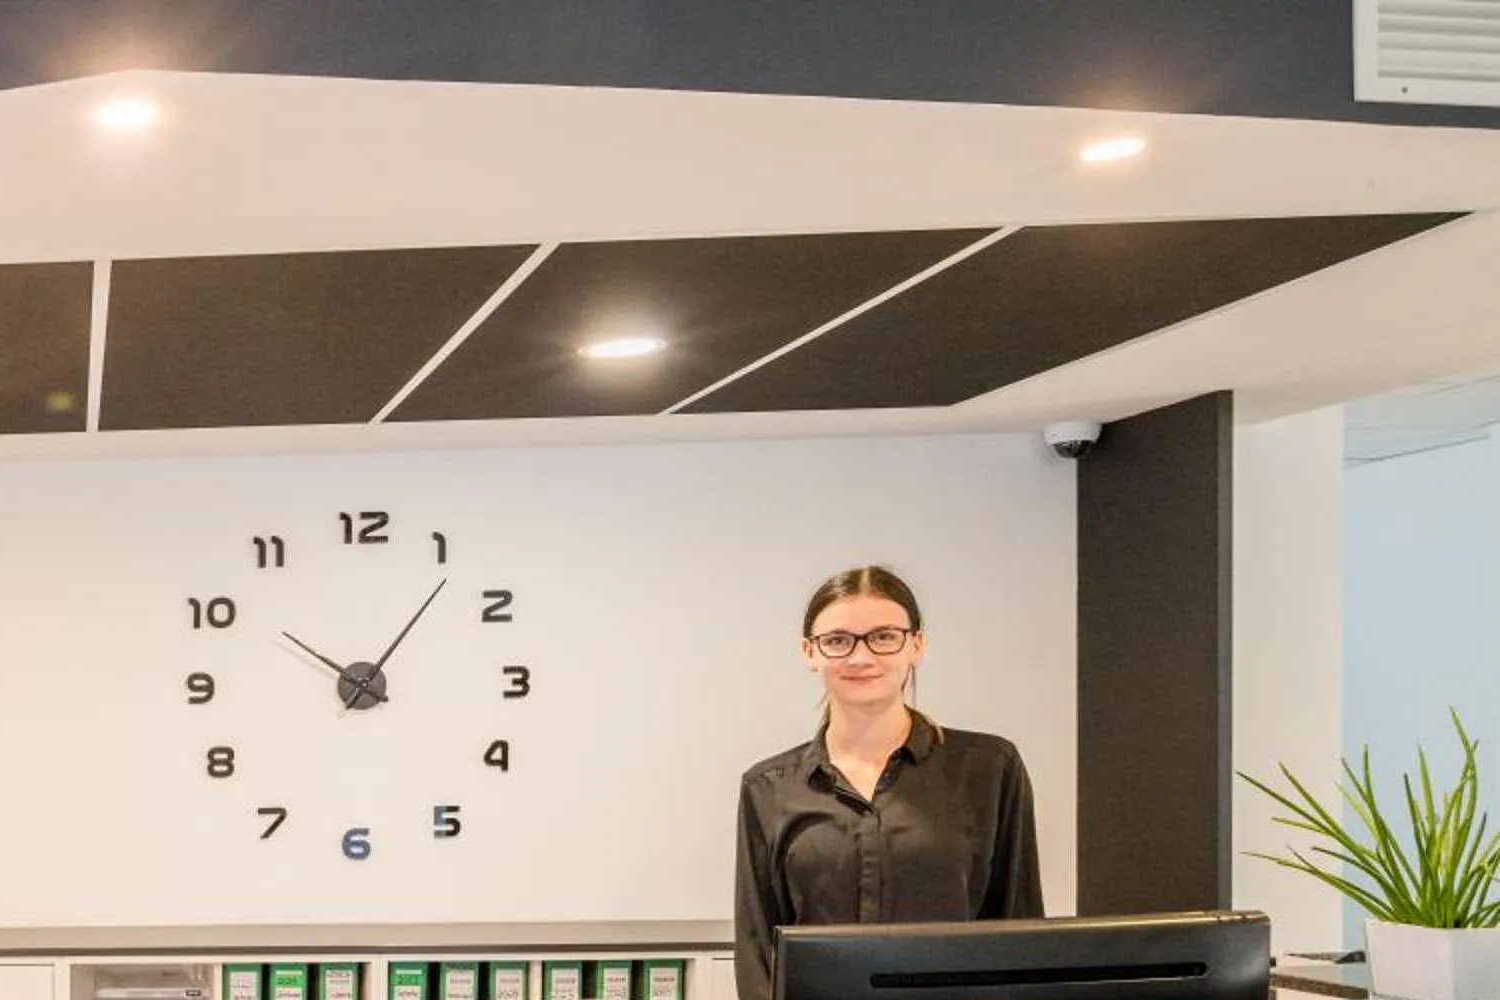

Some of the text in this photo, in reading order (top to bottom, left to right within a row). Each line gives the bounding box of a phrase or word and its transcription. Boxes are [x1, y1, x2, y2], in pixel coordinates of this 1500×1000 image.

[339, 511, 389, 544] 12
[253, 535, 285, 569] 11
[432, 531, 447, 564] 1
[188, 597, 236, 629] 10
[481, 589, 513, 623] 2
[186, 672, 215, 705] 9
[503, 666, 530, 699] 3
[207, 746, 235, 779] 8
[483, 740, 509, 772] 4
[257, 807, 287, 839] 7
[433, 805, 462, 839] 5
[341, 827, 372, 861] 6
